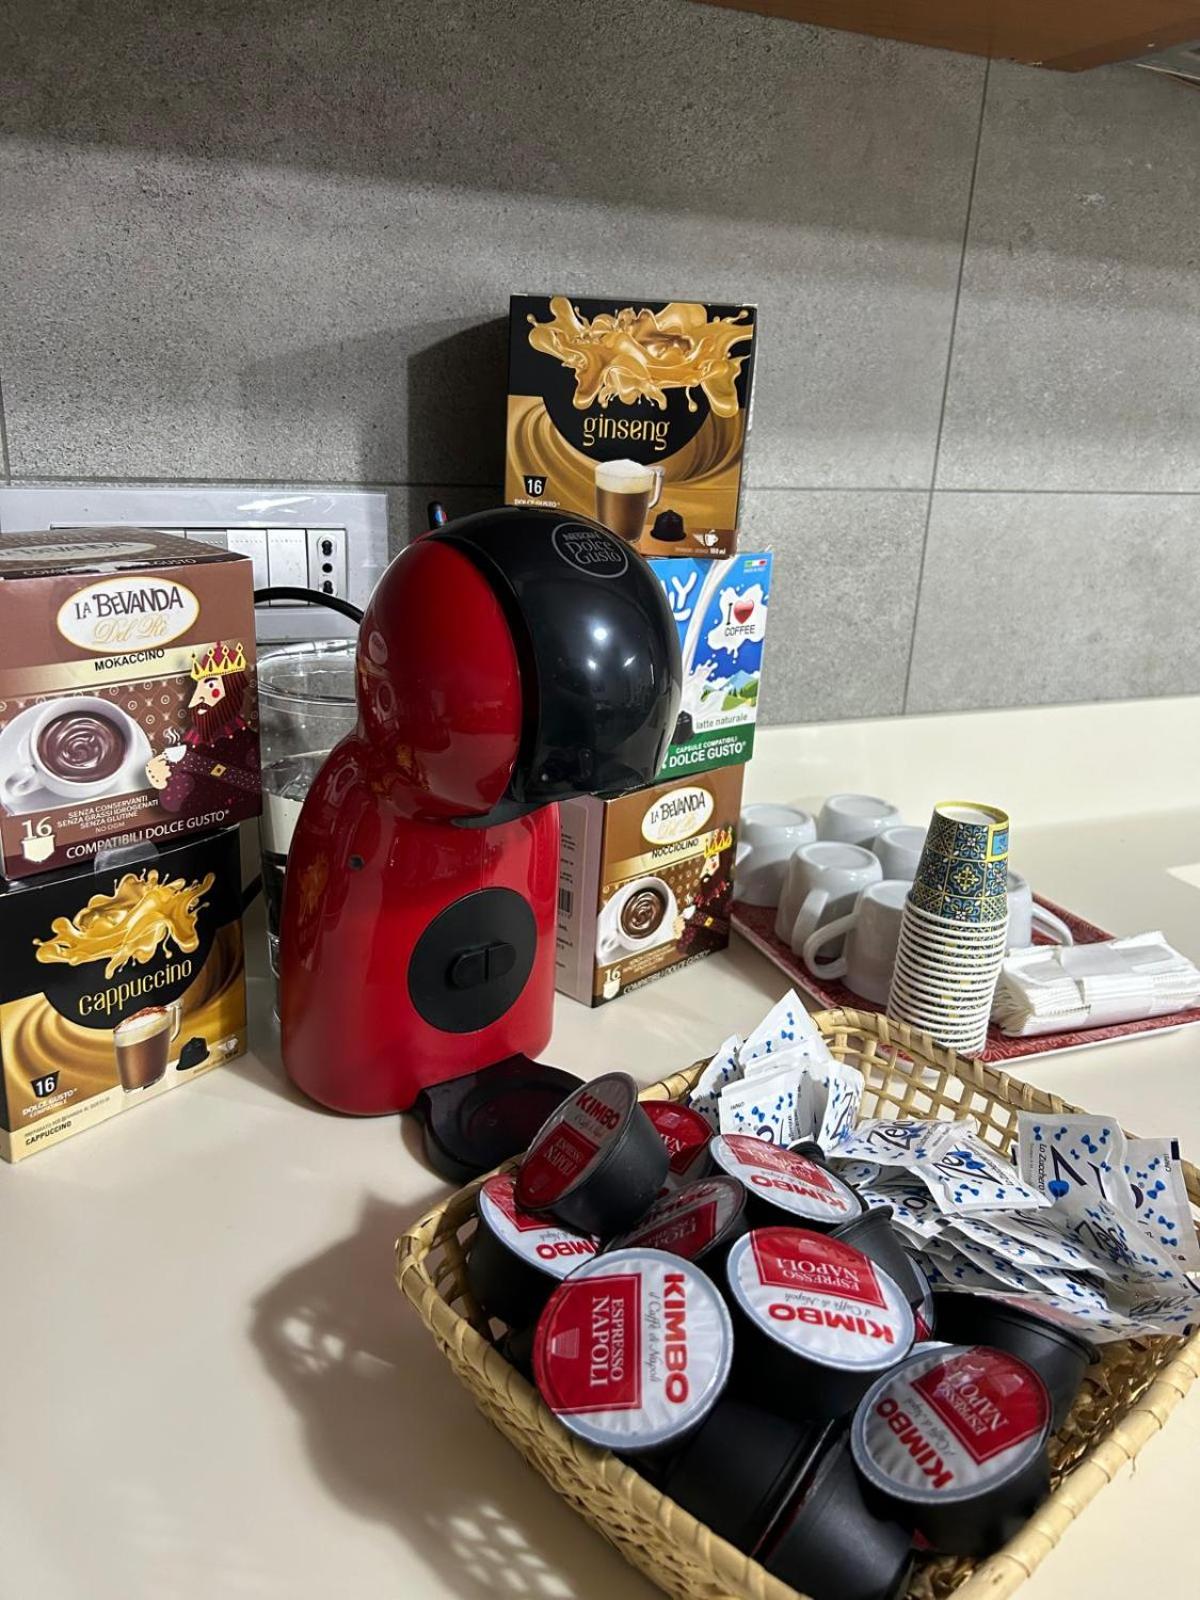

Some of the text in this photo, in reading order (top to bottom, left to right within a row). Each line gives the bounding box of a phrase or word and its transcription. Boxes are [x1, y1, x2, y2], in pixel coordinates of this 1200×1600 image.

[583, 414, 671, 451] ginseng
[527, 479, 543, 495] 16
[564, 539, 614, 553] Dolce
[575, 550, 621, 564] Gusto
[75, 602, 92, 620] LA
[726, 602, 733, 626] I
[725, 624, 756, 637] COFFEE
[94, 648, 165, 672] MOKACCINO
[696, 712, 748, 730] latte naturale
[676, 736, 738, 754] CAPSULE COMPATIBILI
[669, 749, 705, 768] DOLCE
[57, 799, 159, 828] SENZA GRASSI IDROGENATI
[67, 795, 148, 819] SENZA CONSERVANTI
[21, 816, 52, 840] 16
[80, 811, 138, 830] SENZA GLUTINE
[66, 831, 143, 859] COMPATIBILI
[145, 822, 185, 840] DOLCE
[651, 837, 699, 859] NOCCIOLINO
[604, 964, 621, 983] 16
[78, 959, 193, 1016] cappuccino
[36, 1076, 55, 1096] 16
[575, 1091, 621, 1130] KIMBO
[25, 1120, 72, 1146] CAPPUCCINO
[750, 1174, 848, 1212] KIMBO
[775, 1258, 862, 1283] NAPOLI
[782, 1269, 862, 1292] ESPRESSO
[769, 1303, 895, 1344] KIMBO
[589, 1294, 609, 1388] NAPOLI
[610, 1298, 625, 1382] ESPRESSO
[663, 1273, 689, 1405] KIMBO
[876, 1397, 955, 1489] KIMBO
